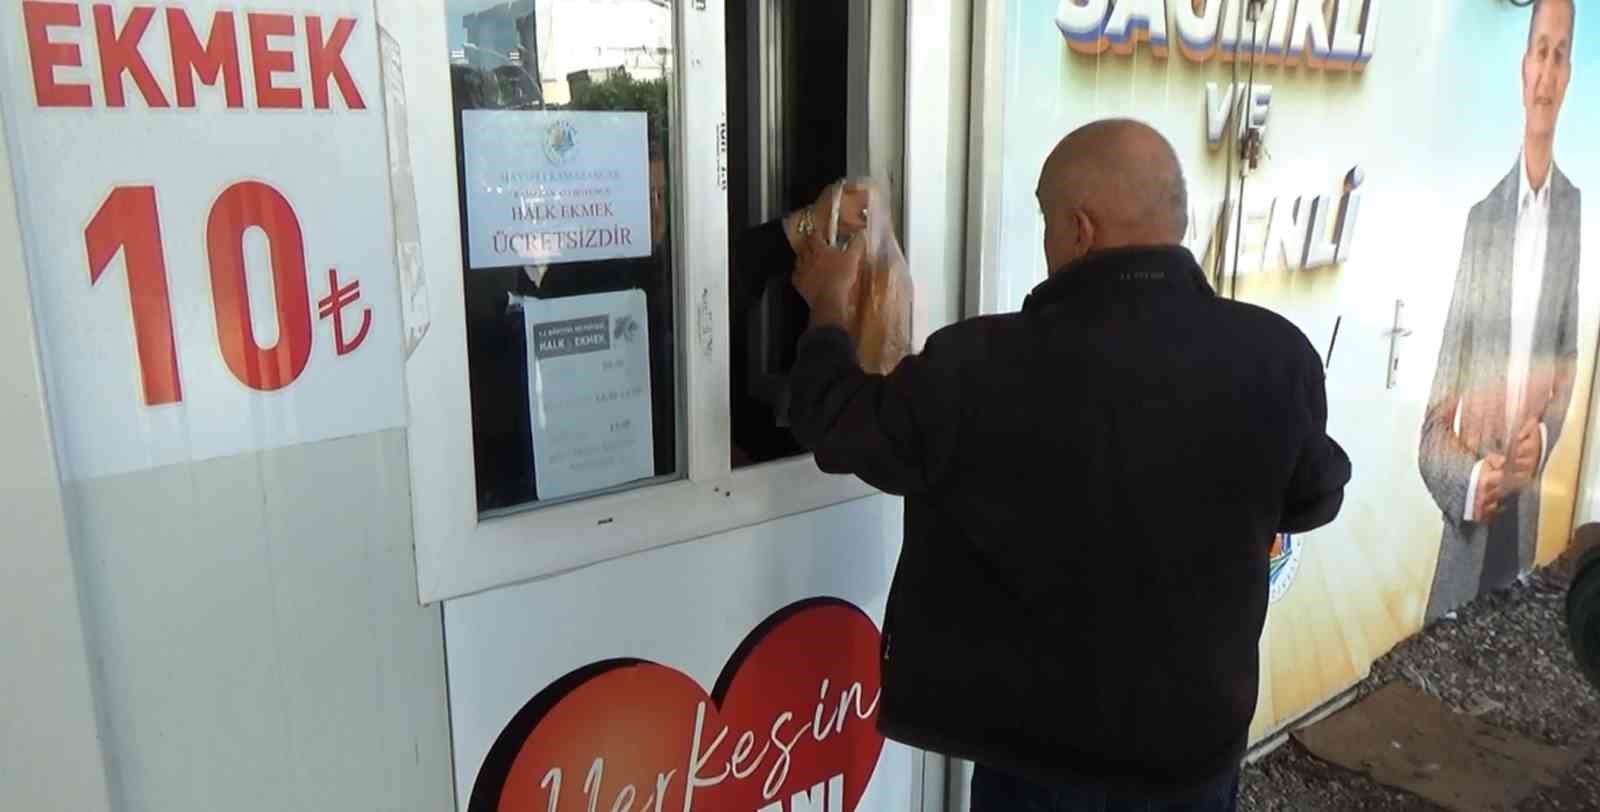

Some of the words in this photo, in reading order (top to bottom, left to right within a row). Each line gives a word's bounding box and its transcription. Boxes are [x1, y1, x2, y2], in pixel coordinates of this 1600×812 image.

[22, 1, 367, 109] EKMEK
[512, 205, 557, 221] HALK
[561, 201, 614, 218] EKMEK
